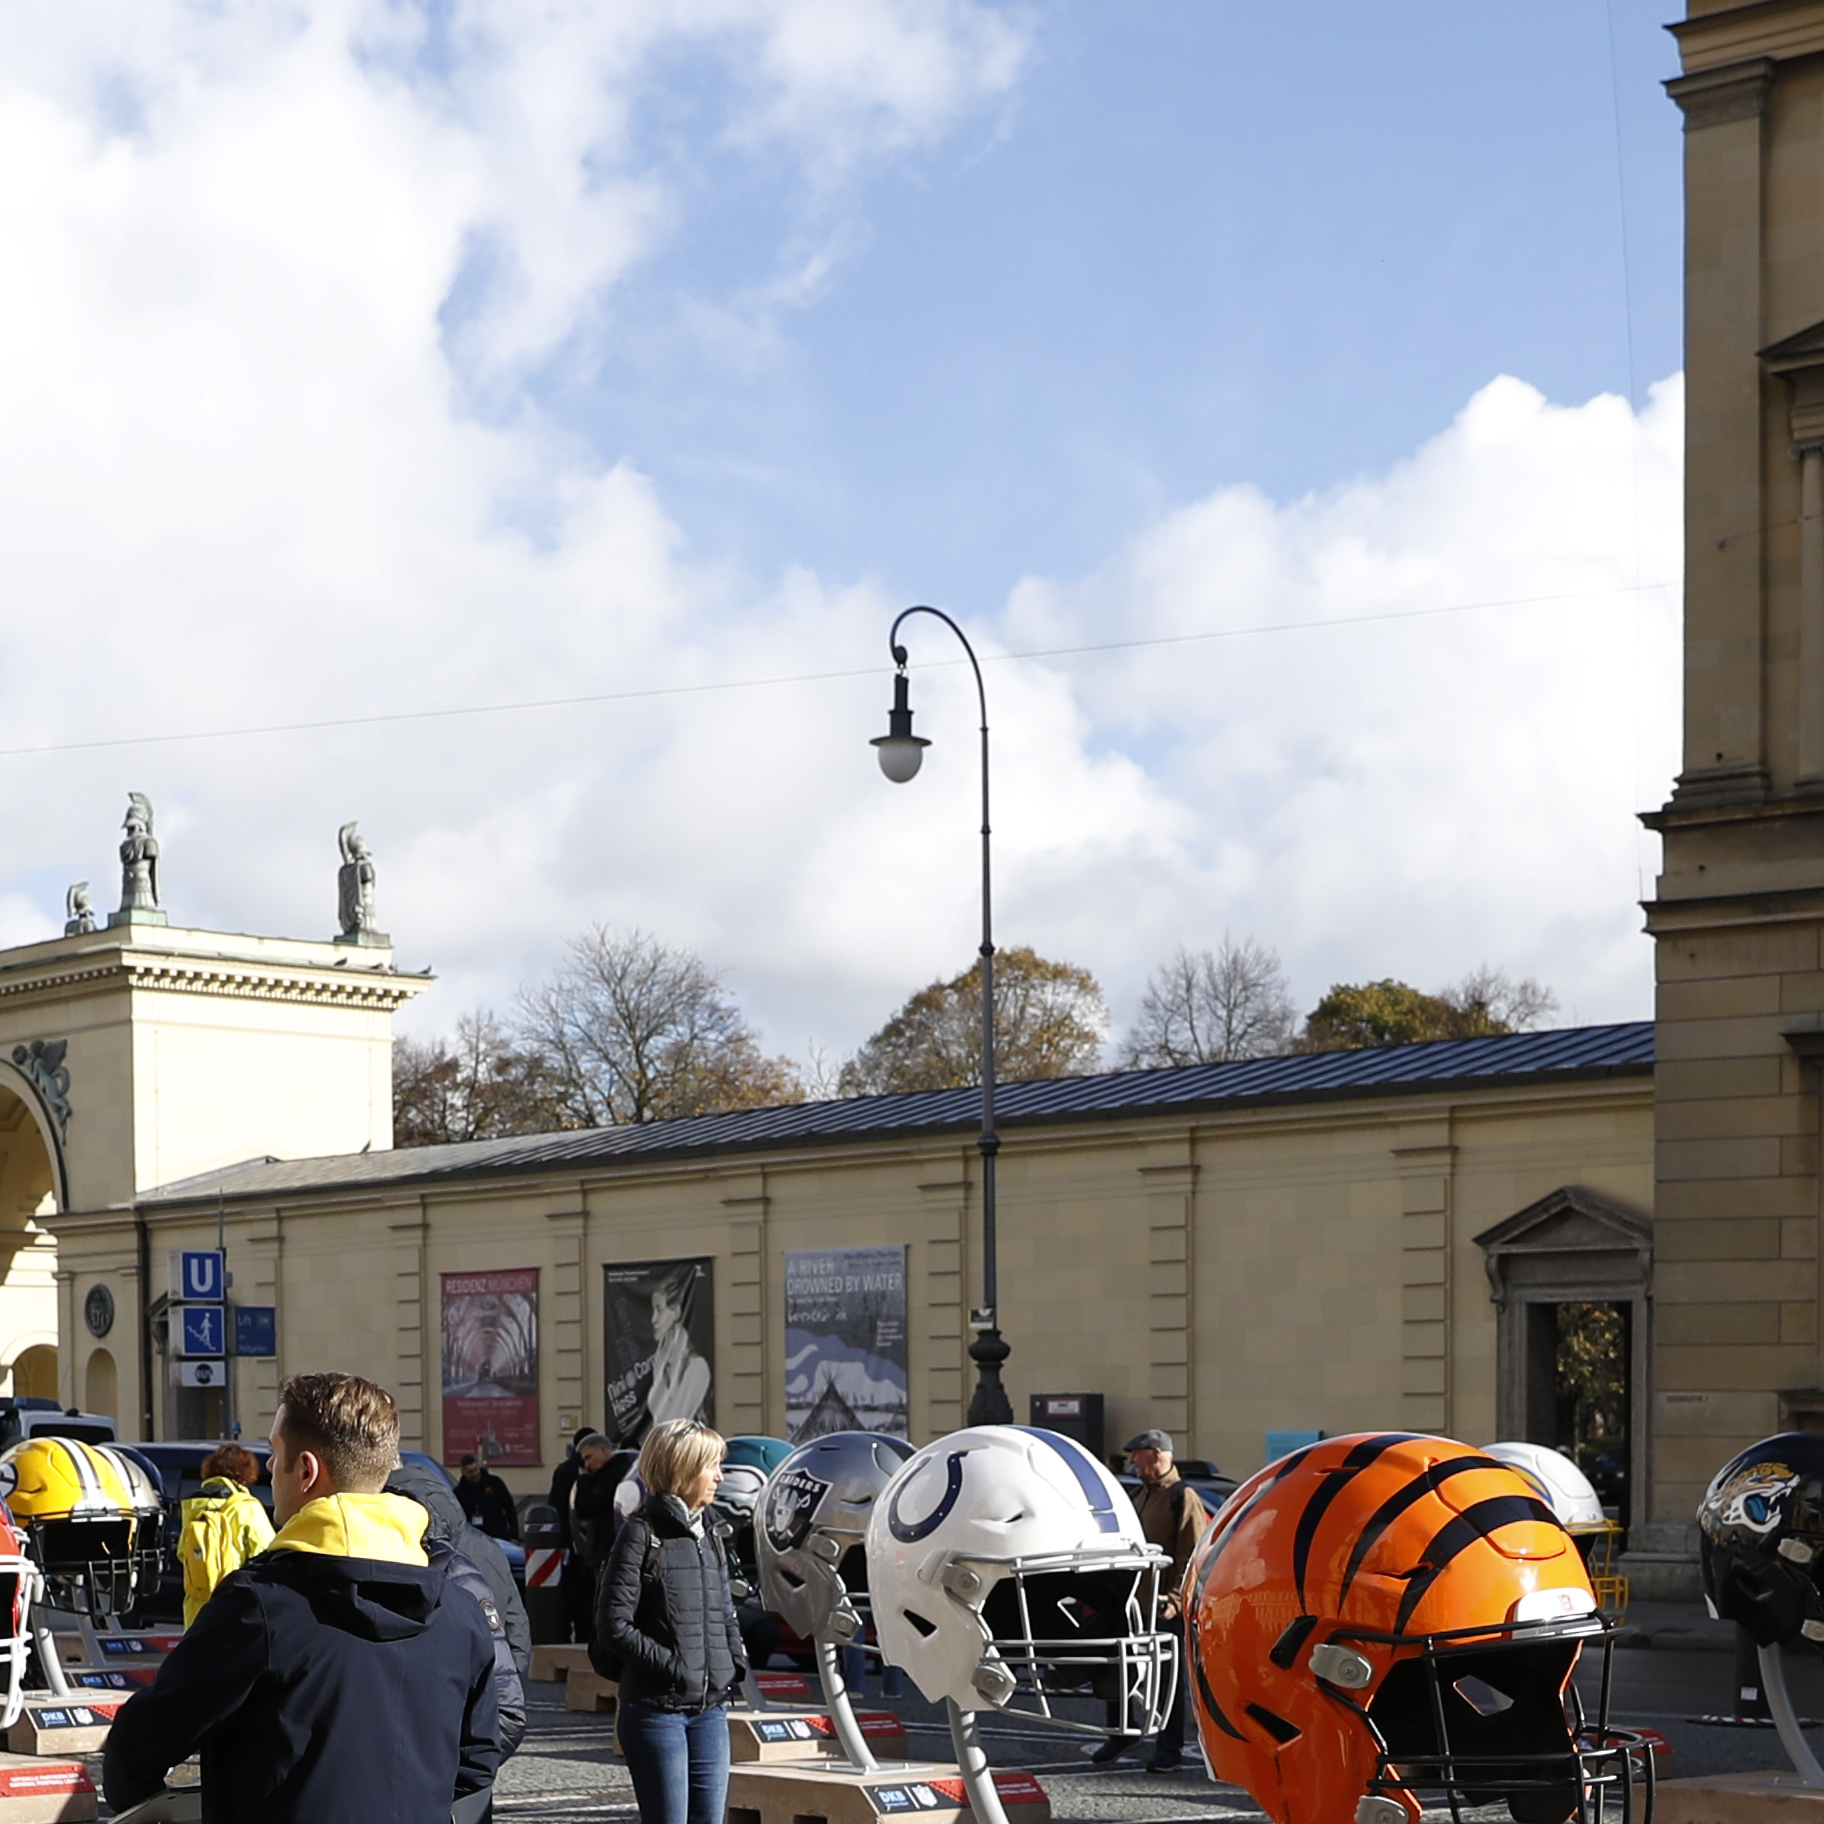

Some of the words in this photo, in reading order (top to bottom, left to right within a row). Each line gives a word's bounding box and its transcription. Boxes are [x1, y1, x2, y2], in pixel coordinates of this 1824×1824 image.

[190, 1258, 213, 1293] U
[799, 1259, 835, 1275] RIVER
[446, 1278, 487, 1294] RESIDENZ
[787, 1277, 843, 1295] DROWNED
[845, 1275, 859, 1293] BY
[862, 1273, 902, 1292] WATER
